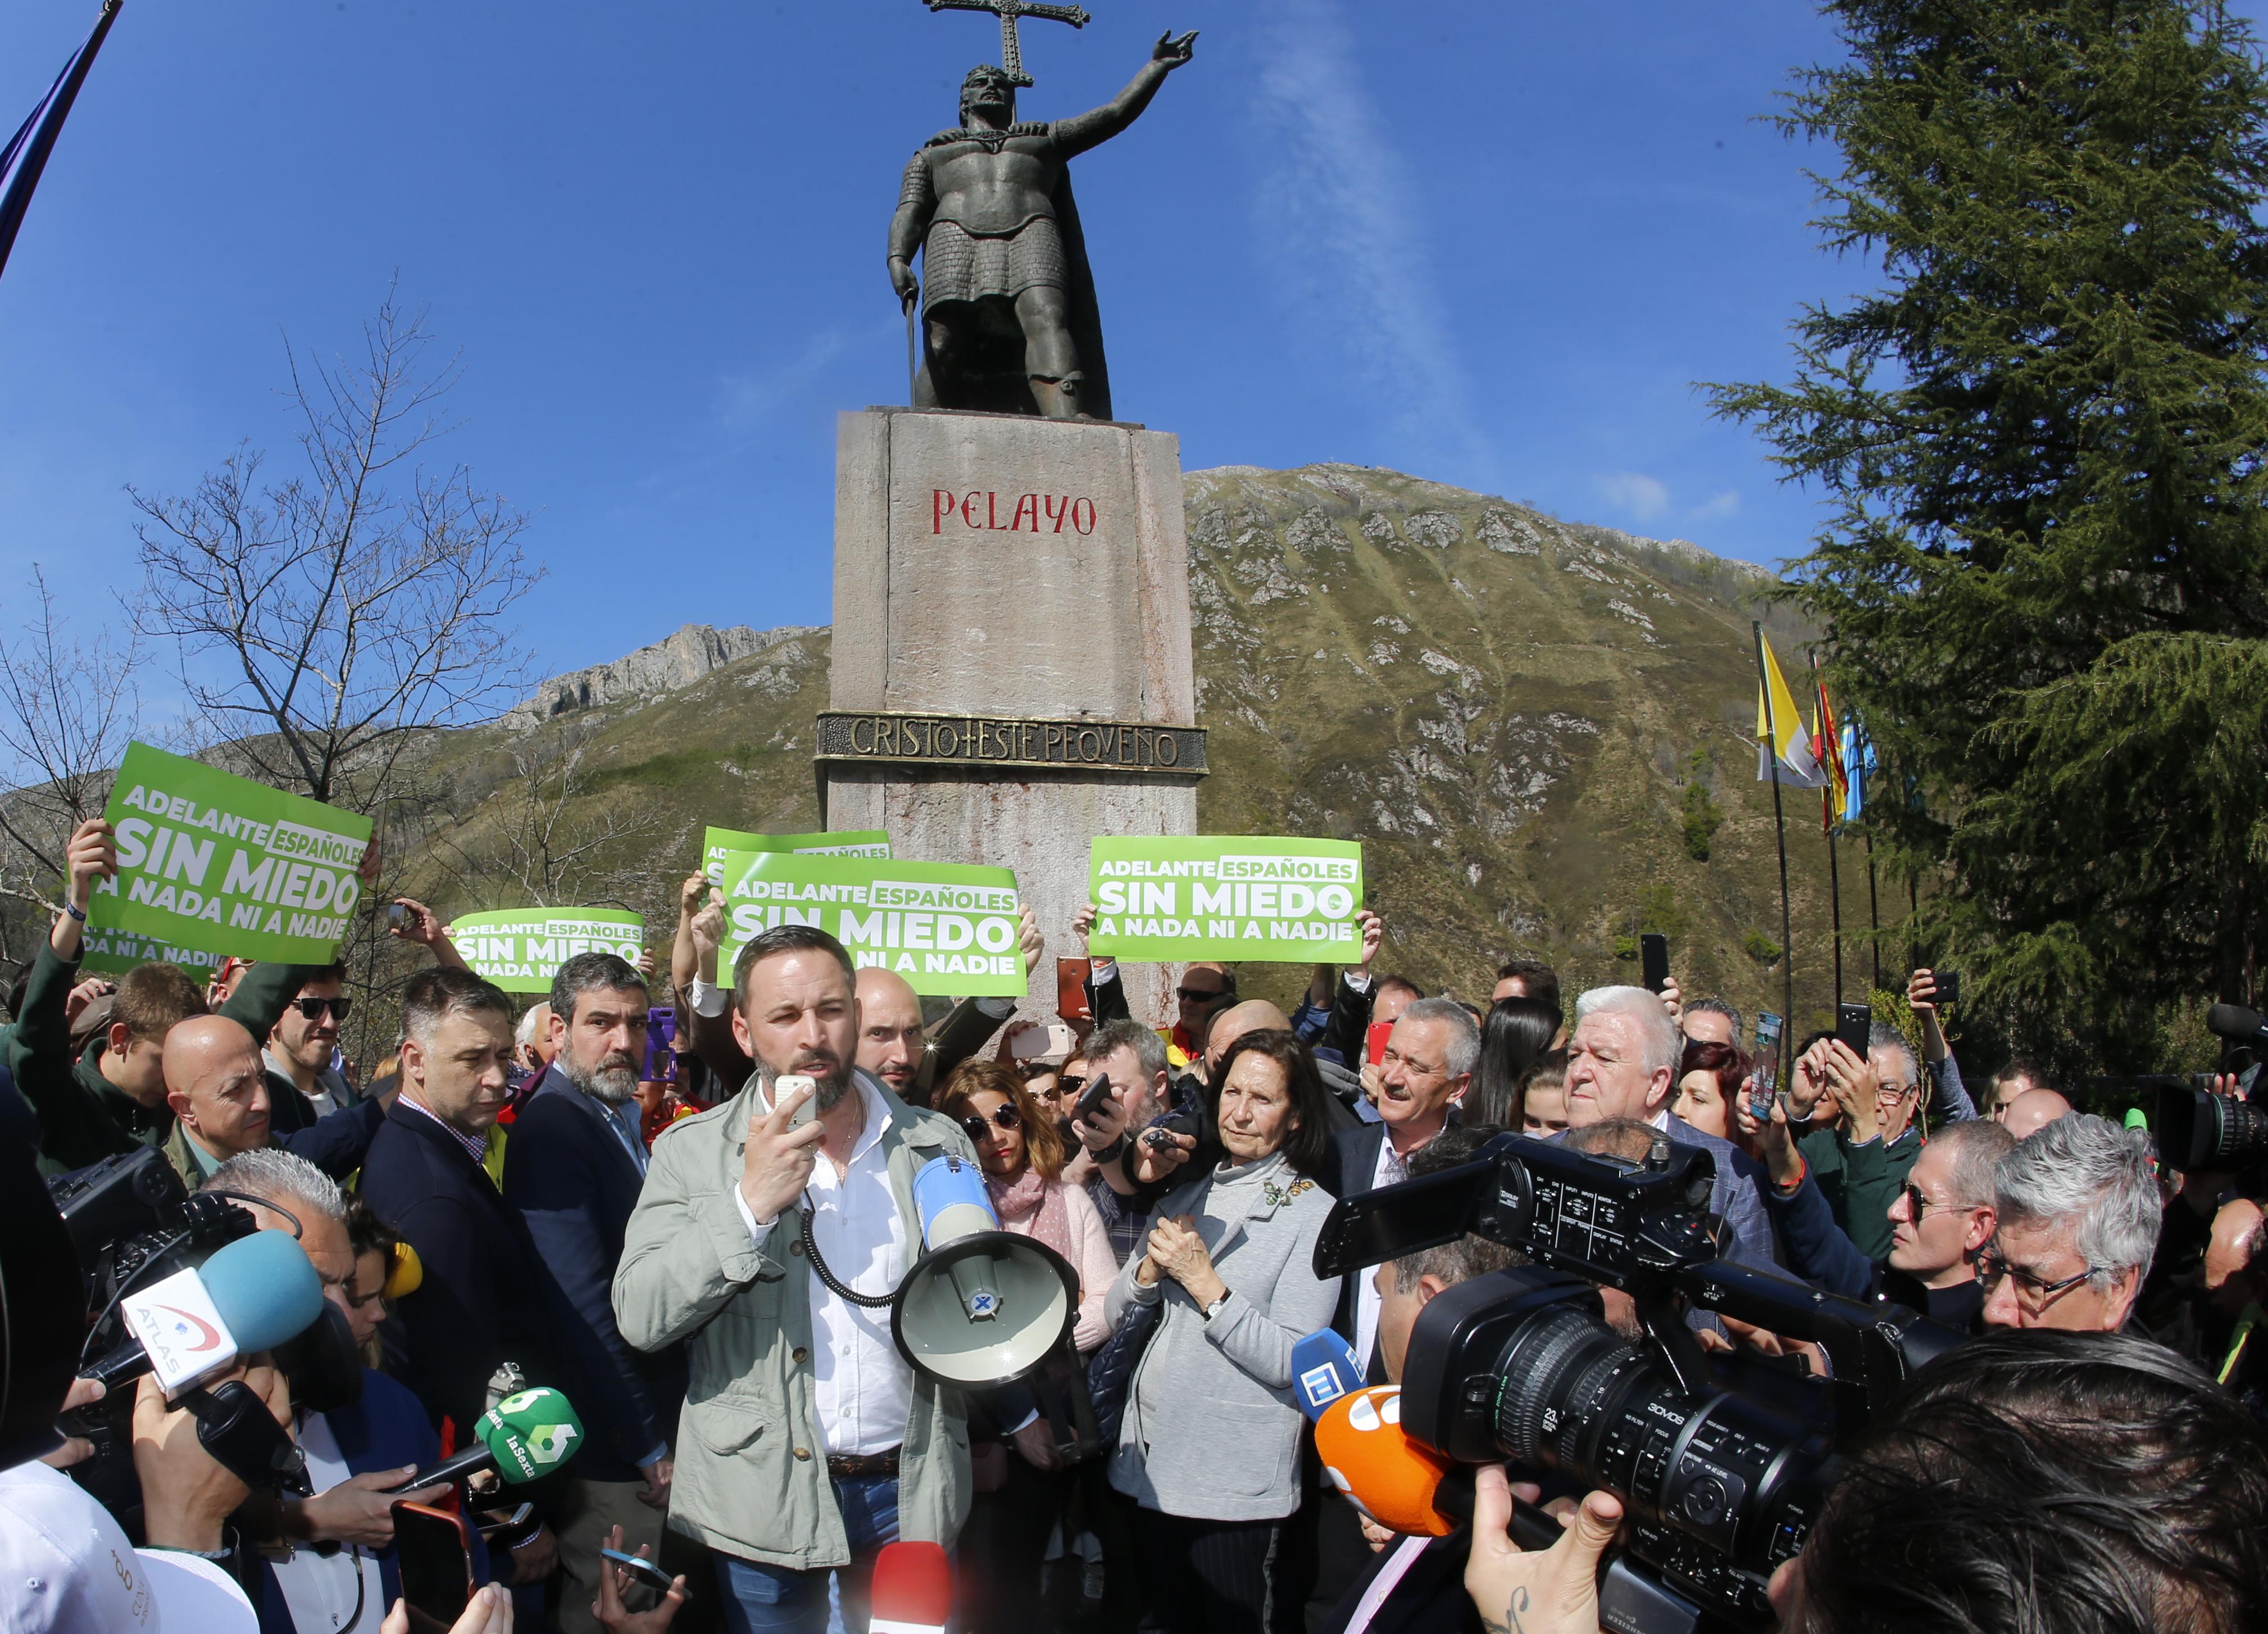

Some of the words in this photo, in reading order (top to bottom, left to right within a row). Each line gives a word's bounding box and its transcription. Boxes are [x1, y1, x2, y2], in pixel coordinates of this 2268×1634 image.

[933, 489, 1097, 535] PELAYO
[850, 718, 959, 757] CRISTO
[978, 720, 1038, 760] ESTE
[122, 784, 271, 846] ADELANTE
[272, 828, 365, 867] ESPAÑOLES
[115, 818, 216, 887] SIN
[221, 849, 359, 915] MIEDO
[1098, 860, 1216, 877] ADELANTE
[1222, 858, 1353, 879] ESPAÑOLES
[96, 873, 119, 897] A
[127, 876, 221, 924] NADA
[229, 902, 262, 931] NI
[262, 910, 281, 934] A
[287, 913, 348, 940] NADIE
[732, 880, 867, 904] ADELANTE
[875, 886, 1015, 911] ESPAÑOLES
[1098, 881, 1175, 915] SIN
[1192, 882, 1353, 920] MIEDO
[456, 923, 544, 938] ADELANTE
[548, 922, 640, 941] ESPAÑOLES
[731, 904, 821, 942] SIN
[839, 909, 1015, 954] MIEDO
[1098, 918, 1118, 936] A
[1125, 918, 1202, 938] NADA
[1209, 920, 1235, 939] NI
[1243, 921, 1263, 939] A
[1270, 921, 1353, 941] NADIE
[84, 936, 110, 955] DA
[116, 941, 137, 957] NI
[142, 944, 158, 960] A
[454, 938, 514, 961] SIN
[475, 963, 534, 977] NADA
[539, 965, 559, 978] NI
[857, 950, 886, 969] NI
[894, 952, 917, 972] A
[925, 953, 1016, 975] NADIE
[137, 1308, 180, 1374] ATLAS
[1631, 1417, 1644, 1426] FILTER
[1648, 1402, 1685, 1426] 3CMOS
[1655, 1428, 1669, 1438] FOCUS
[506, 1435, 535, 1478] laSexta
[1716, 1469, 1728, 1479] LEVEL
[1788, 1504, 1803, 1515] POWER
[1775, 1548, 1788, 1558] MODE
